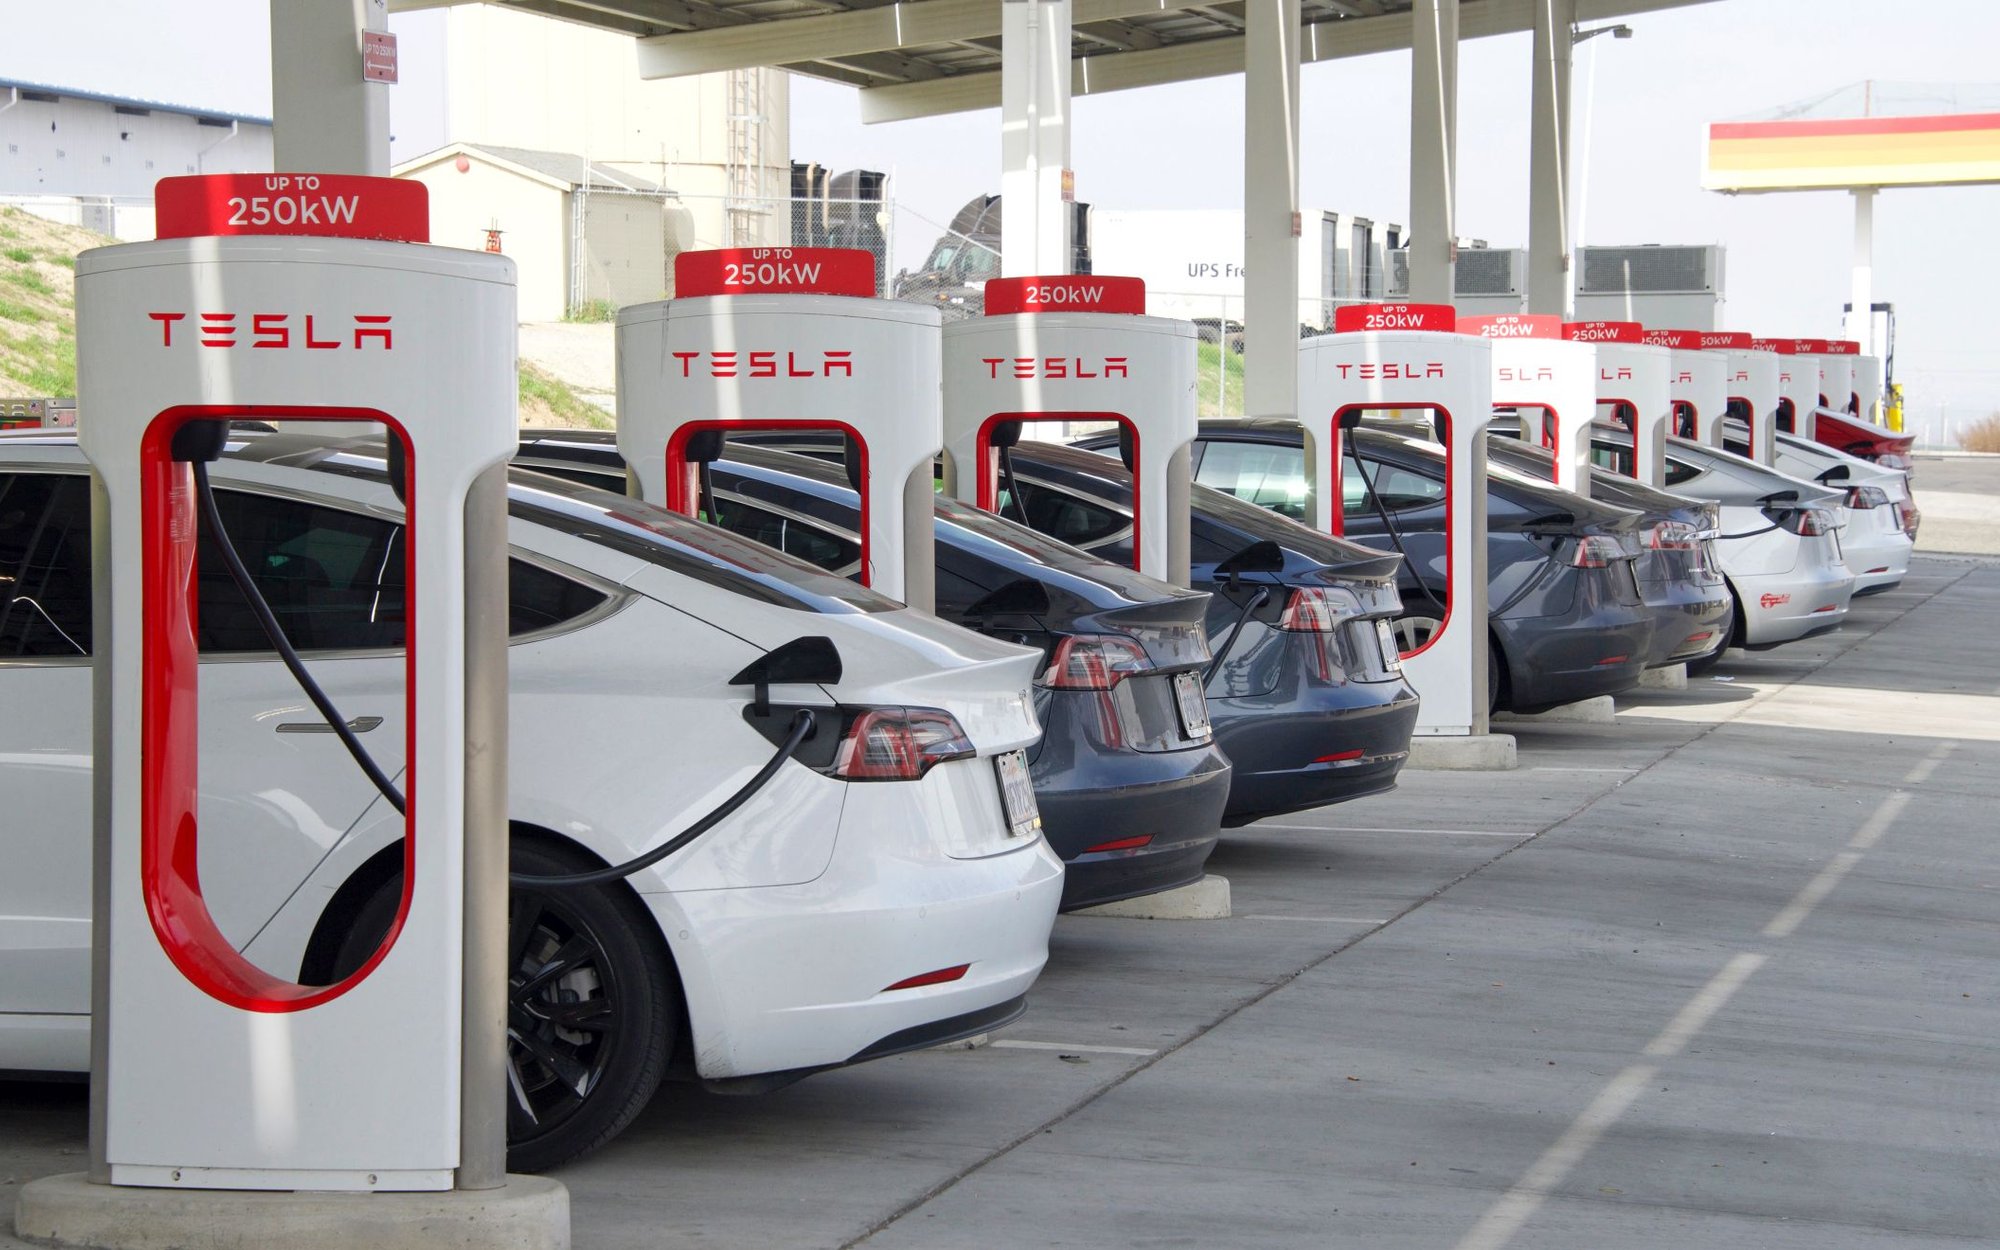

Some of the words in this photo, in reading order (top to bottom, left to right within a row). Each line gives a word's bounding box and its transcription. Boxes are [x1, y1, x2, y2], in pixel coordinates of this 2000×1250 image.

[265, 177, 290, 191] UP
[294, 176, 320, 190] TO
[227, 195, 359, 226] 250kW
[752, 249, 771, 260] UP
[774, 248, 793, 260] TO
[724, 263, 822, 286] 250kW
[1188, 262, 1219, 278] UPS
[1025, 286, 1104, 304] 250kW
[1365, 314, 1424, 328] 250kW
[148, 313, 392, 350] TESLA
[1481, 323, 1533, 337] 250kW
[1572, 328, 1619, 341] 250kW
[1701, 336, 1733, 346] 50kW
[672, 351, 852, 378] TESLA
[981, 357, 1128, 379] TESLA
[1336, 363, 1443, 379] TESLA
[1499, 368, 1552, 381] SLA
